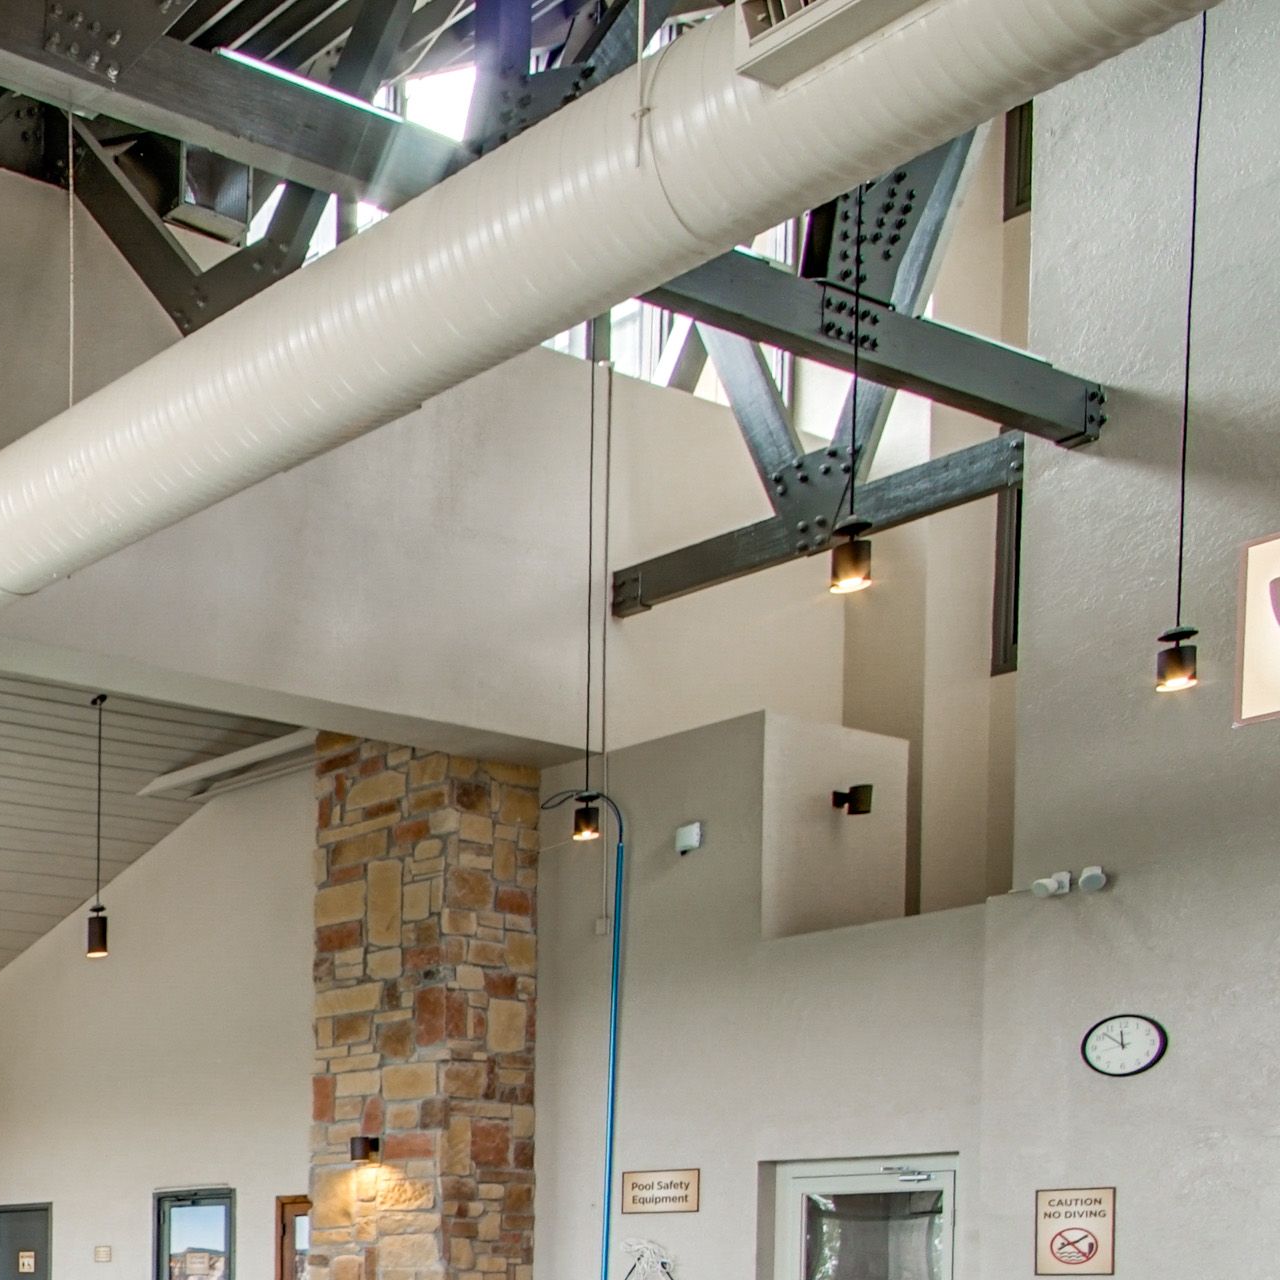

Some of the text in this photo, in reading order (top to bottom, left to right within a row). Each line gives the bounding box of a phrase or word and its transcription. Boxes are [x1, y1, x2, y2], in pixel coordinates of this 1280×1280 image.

[631, 1180, 690, 1191] Pool Safety
[632, 1194, 688, 1205] Equipment
[1048, 1198, 1102, 1207] CAUTION
[1043, 1210, 1107, 1219] NO DIVING
